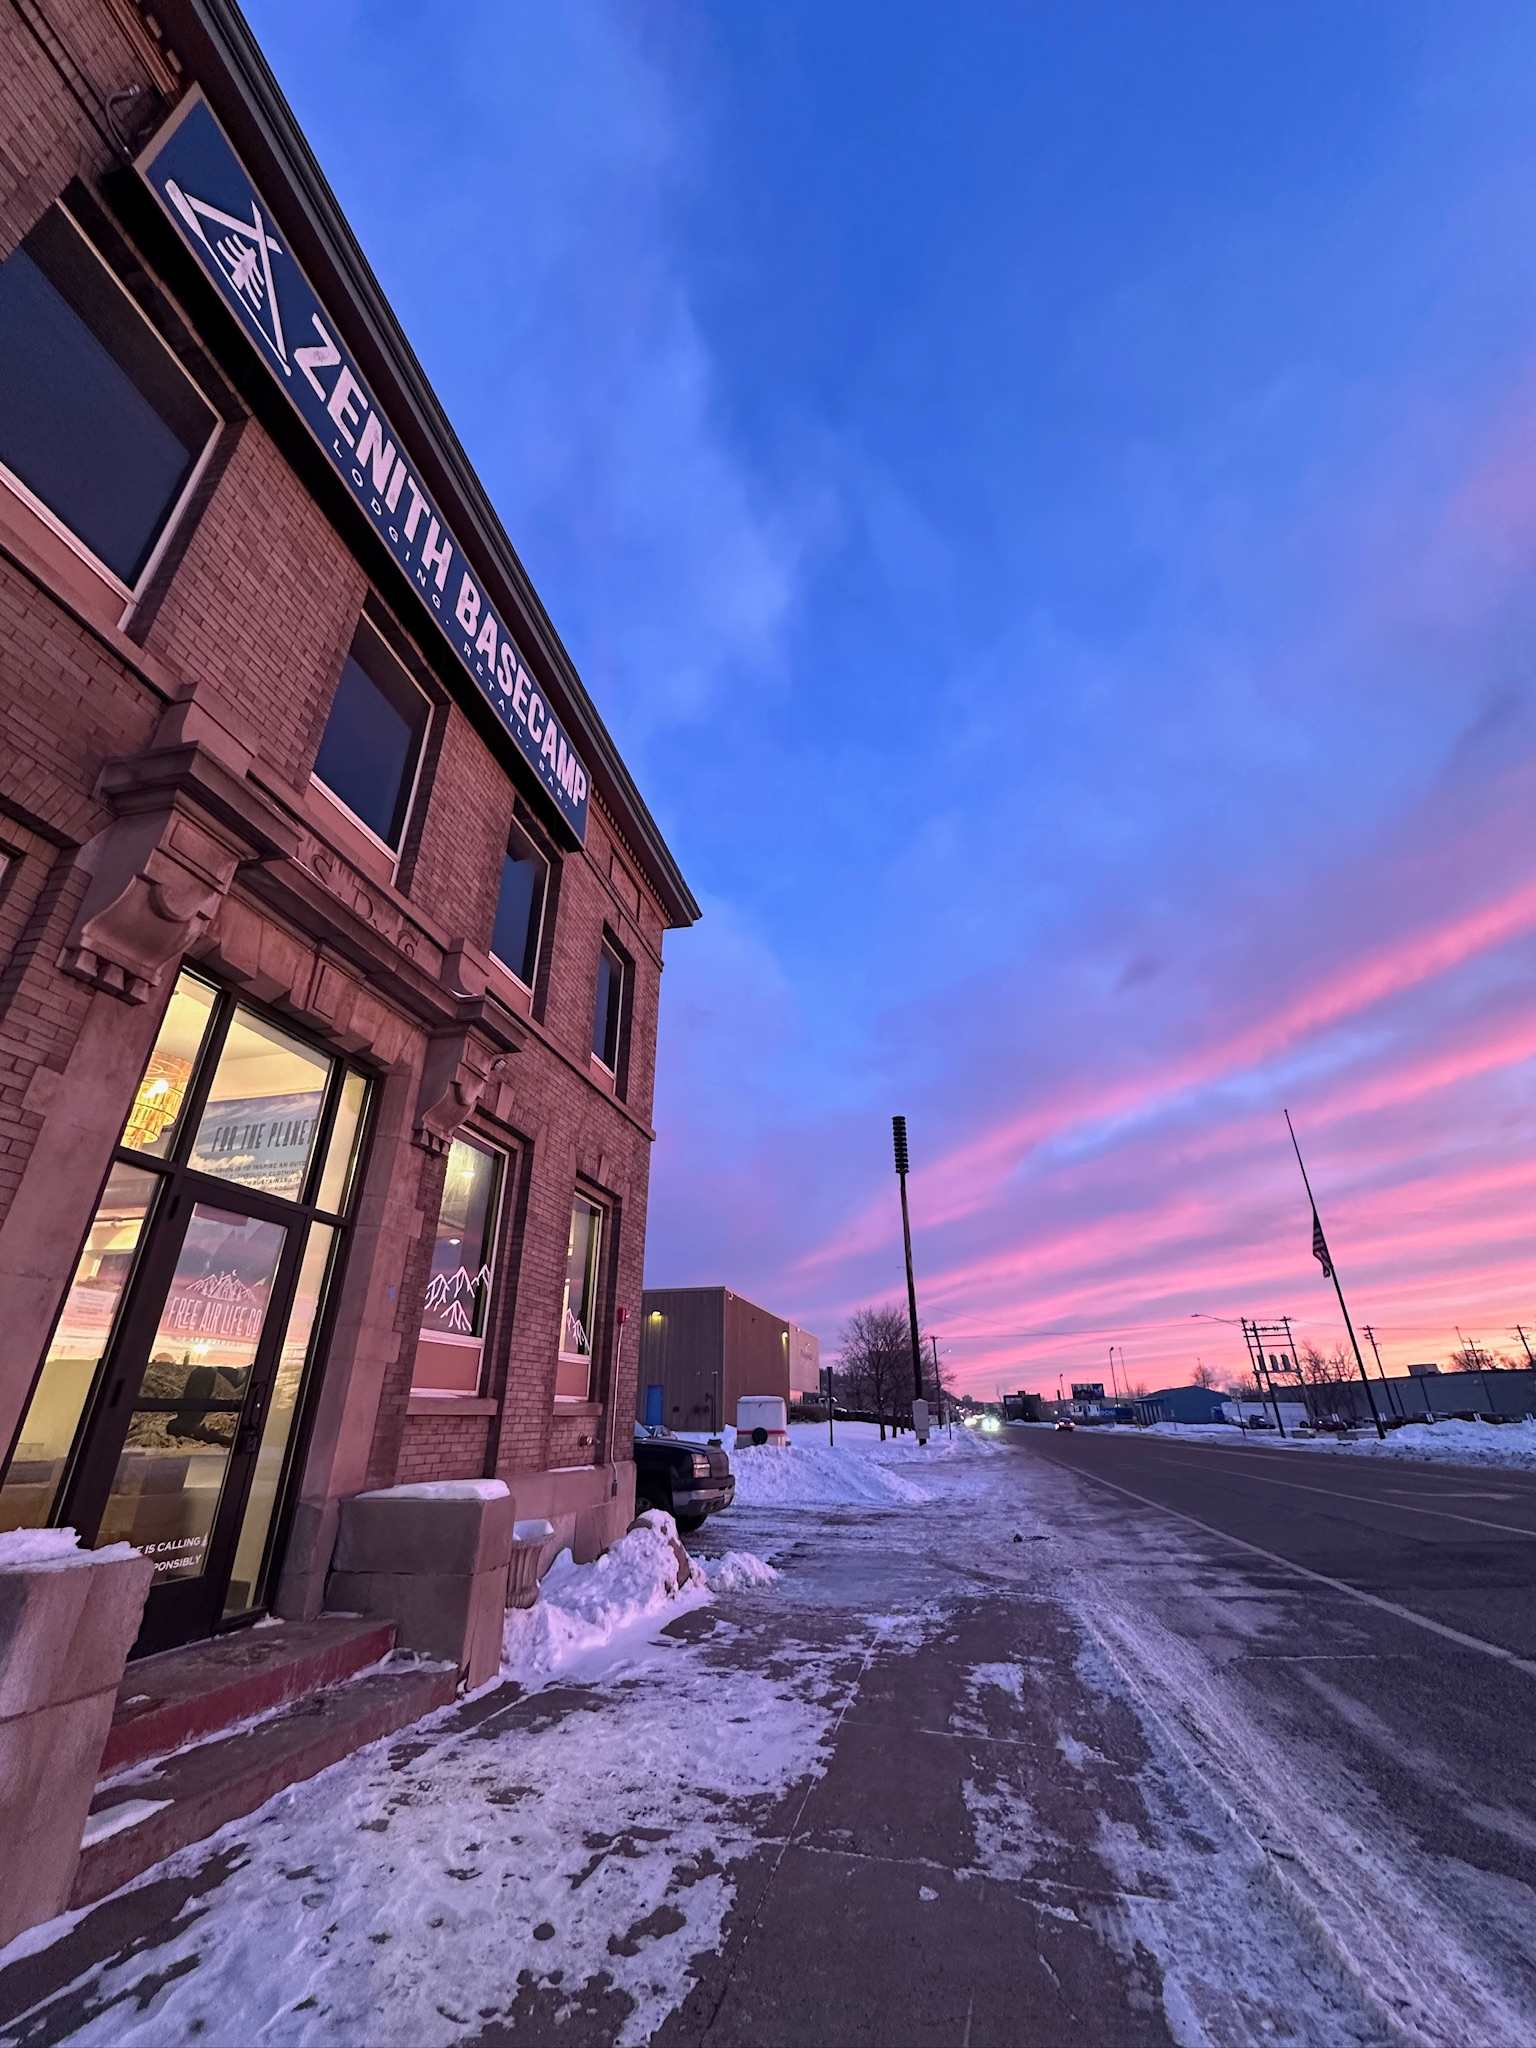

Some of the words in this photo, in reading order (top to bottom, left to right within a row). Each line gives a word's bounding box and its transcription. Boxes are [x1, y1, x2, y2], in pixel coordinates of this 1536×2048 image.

[294, 312, 453, 592] ZENITH
[455, 571, 587, 807] BASECAMP
[211, 1126, 238, 1152] FOR
[240, 1123, 266, 1150] THE
[267, 1119, 317, 1148] PLANET
[167, 1296, 201, 1330] FREE
[199, 1301, 224, 1333] AIR
[220, 1305, 248, 1336] LIFE
[144, 1543, 156, 1554] IS
[157, 1536, 201, 1552] CALLING
